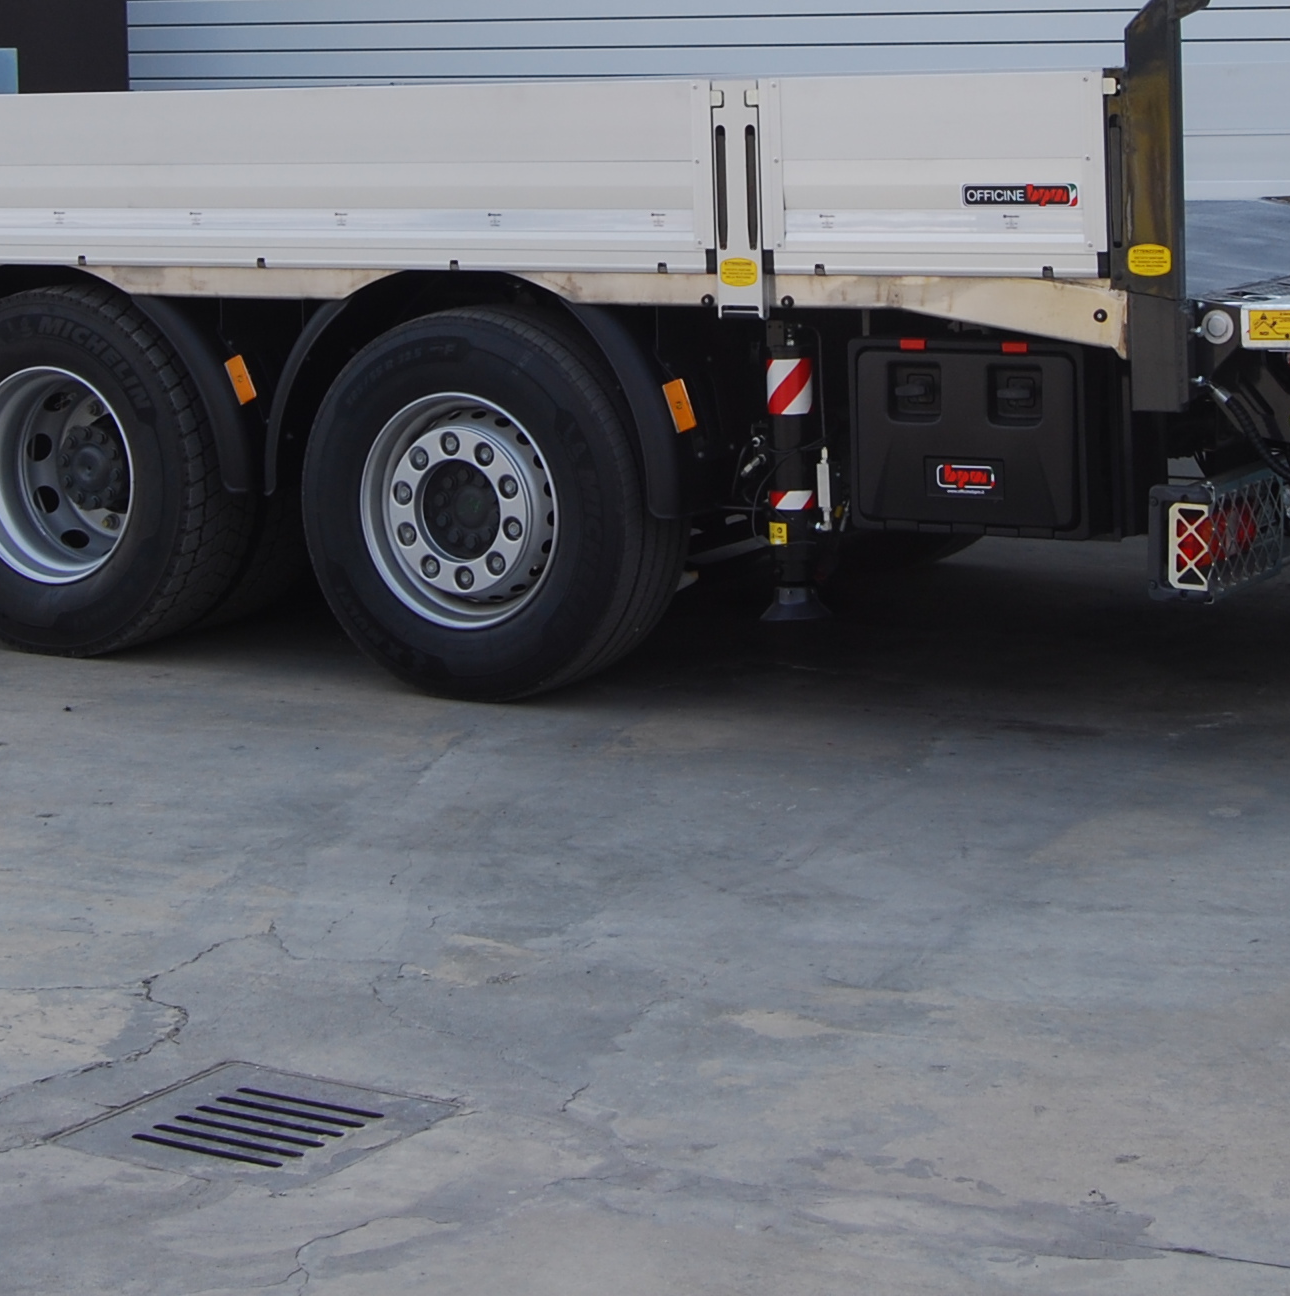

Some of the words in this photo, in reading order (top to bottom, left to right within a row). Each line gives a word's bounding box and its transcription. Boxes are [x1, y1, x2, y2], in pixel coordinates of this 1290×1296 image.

[966, 189, 1025, 202] OFFICINE
[1025, 184, 1068, 206] bpm
[35, 315, 143, 403] MICHELIN
[944, 463, 987, 489] bpm
